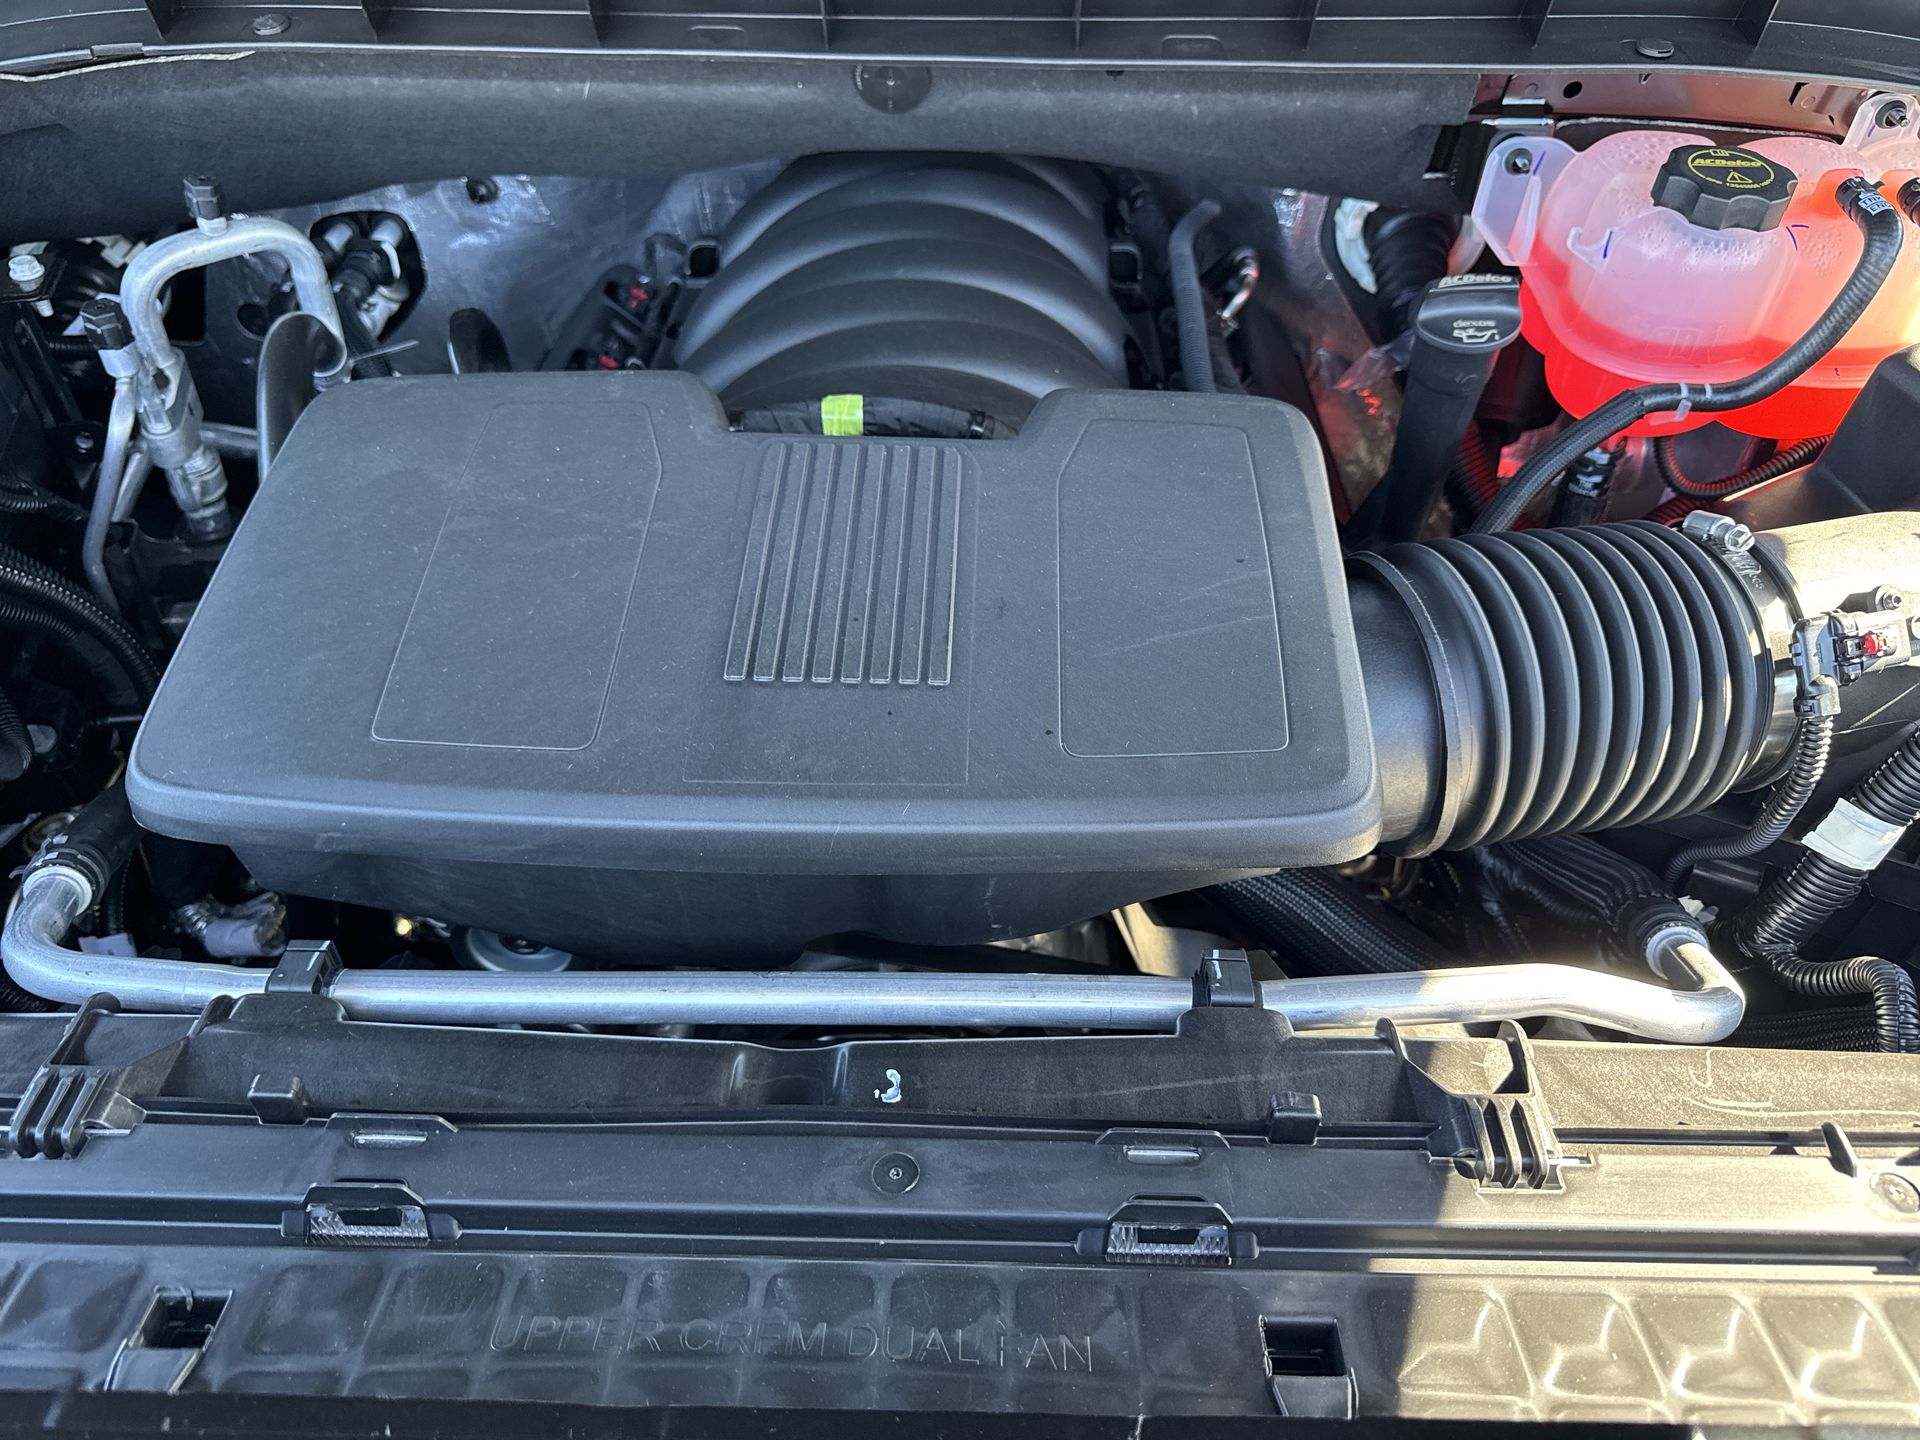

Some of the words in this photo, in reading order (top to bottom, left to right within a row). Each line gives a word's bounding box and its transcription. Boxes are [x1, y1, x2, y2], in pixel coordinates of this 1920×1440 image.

[1693, 158, 1761, 167] ACDelco
[1439, 273, 1511, 287] ACDelco
[1453, 319, 1496, 328] dexos
[489, 1314, 661, 1352] UPPER
[847, 1323, 980, 1365] DUAL
